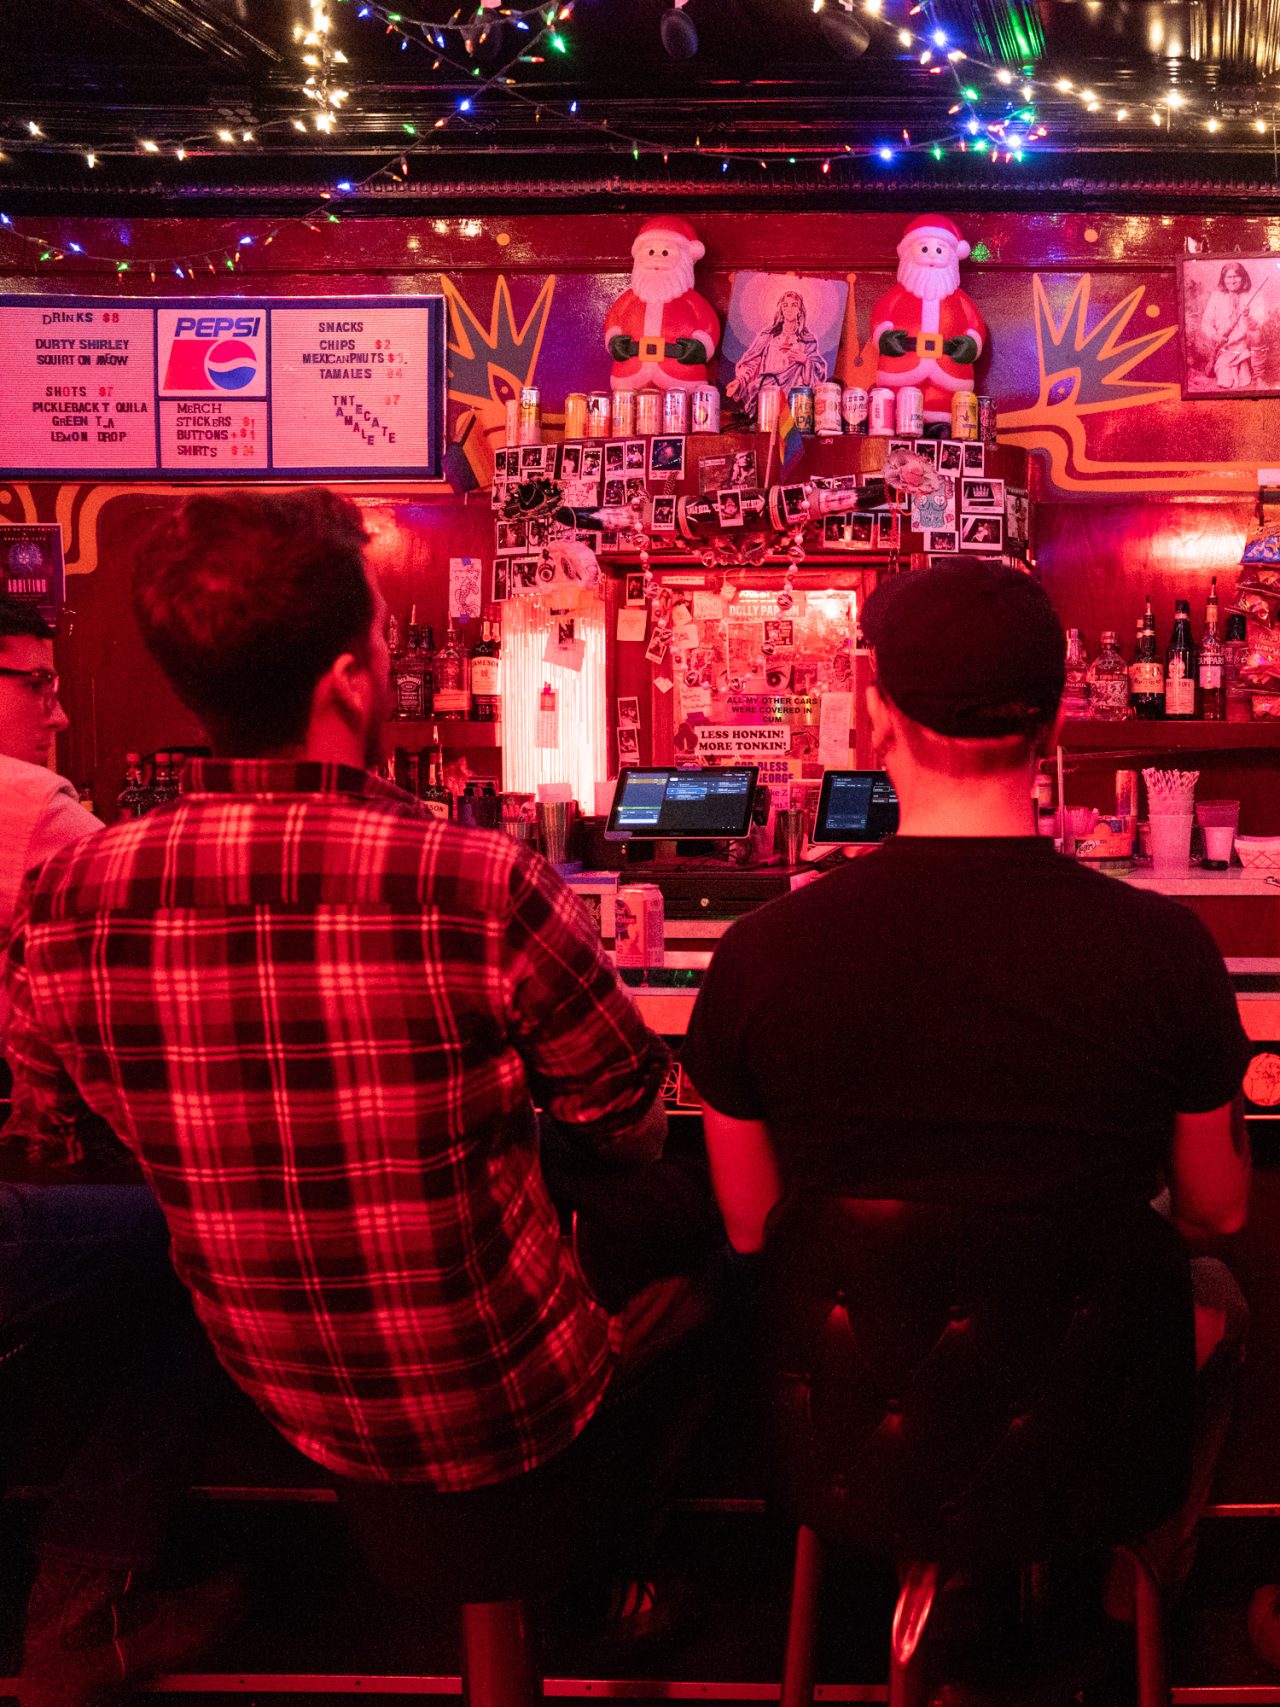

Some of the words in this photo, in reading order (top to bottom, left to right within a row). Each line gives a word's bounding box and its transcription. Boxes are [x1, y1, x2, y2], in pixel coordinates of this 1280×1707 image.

[43, 312, 93, 324] DRINKS
[102, 313, 119, 322] $8
[175, 317, 261, 337] PEPSI
[318, 322, 363, 332] SNACKS
[35, 339, 75, 349] DURTY
[79, 340, 128, 349] SHIRLEY
[319, 340, 355, 350] CHIPS
[375, 339, 391, 349] $2
[37, 355, 74, 365] SQUIRT
[320, 369, 372, 379] TAMALES
[46, 386, 86, 396] SHOTS
[33, 402, 99, 412] PICKLEBACK
[177, 403, 222, 413] MERCH
[52, 416, 88, 426] GREEN
[176, 416, 231, 426] STICKERS
[51, 432, 87, 441] LEMON
[97, 432, 126, 442] DROP
[177, 430, 228, 440] BUTTONS
[177, 445, 217, 457] SHIRTS
[729, 605, 760, 616] DOLLY
[761, 605, 799, 616] PARON
[759, 706, 800, 714] COVERED
[701, 730, 729, 739] LESS
[733, 730, 784, 739] HONKIN!
[699, 742, 732, 750] MORE
[736, 742, 787, 750] TONKIN!
[758, 761, 788, 771] BLESS
